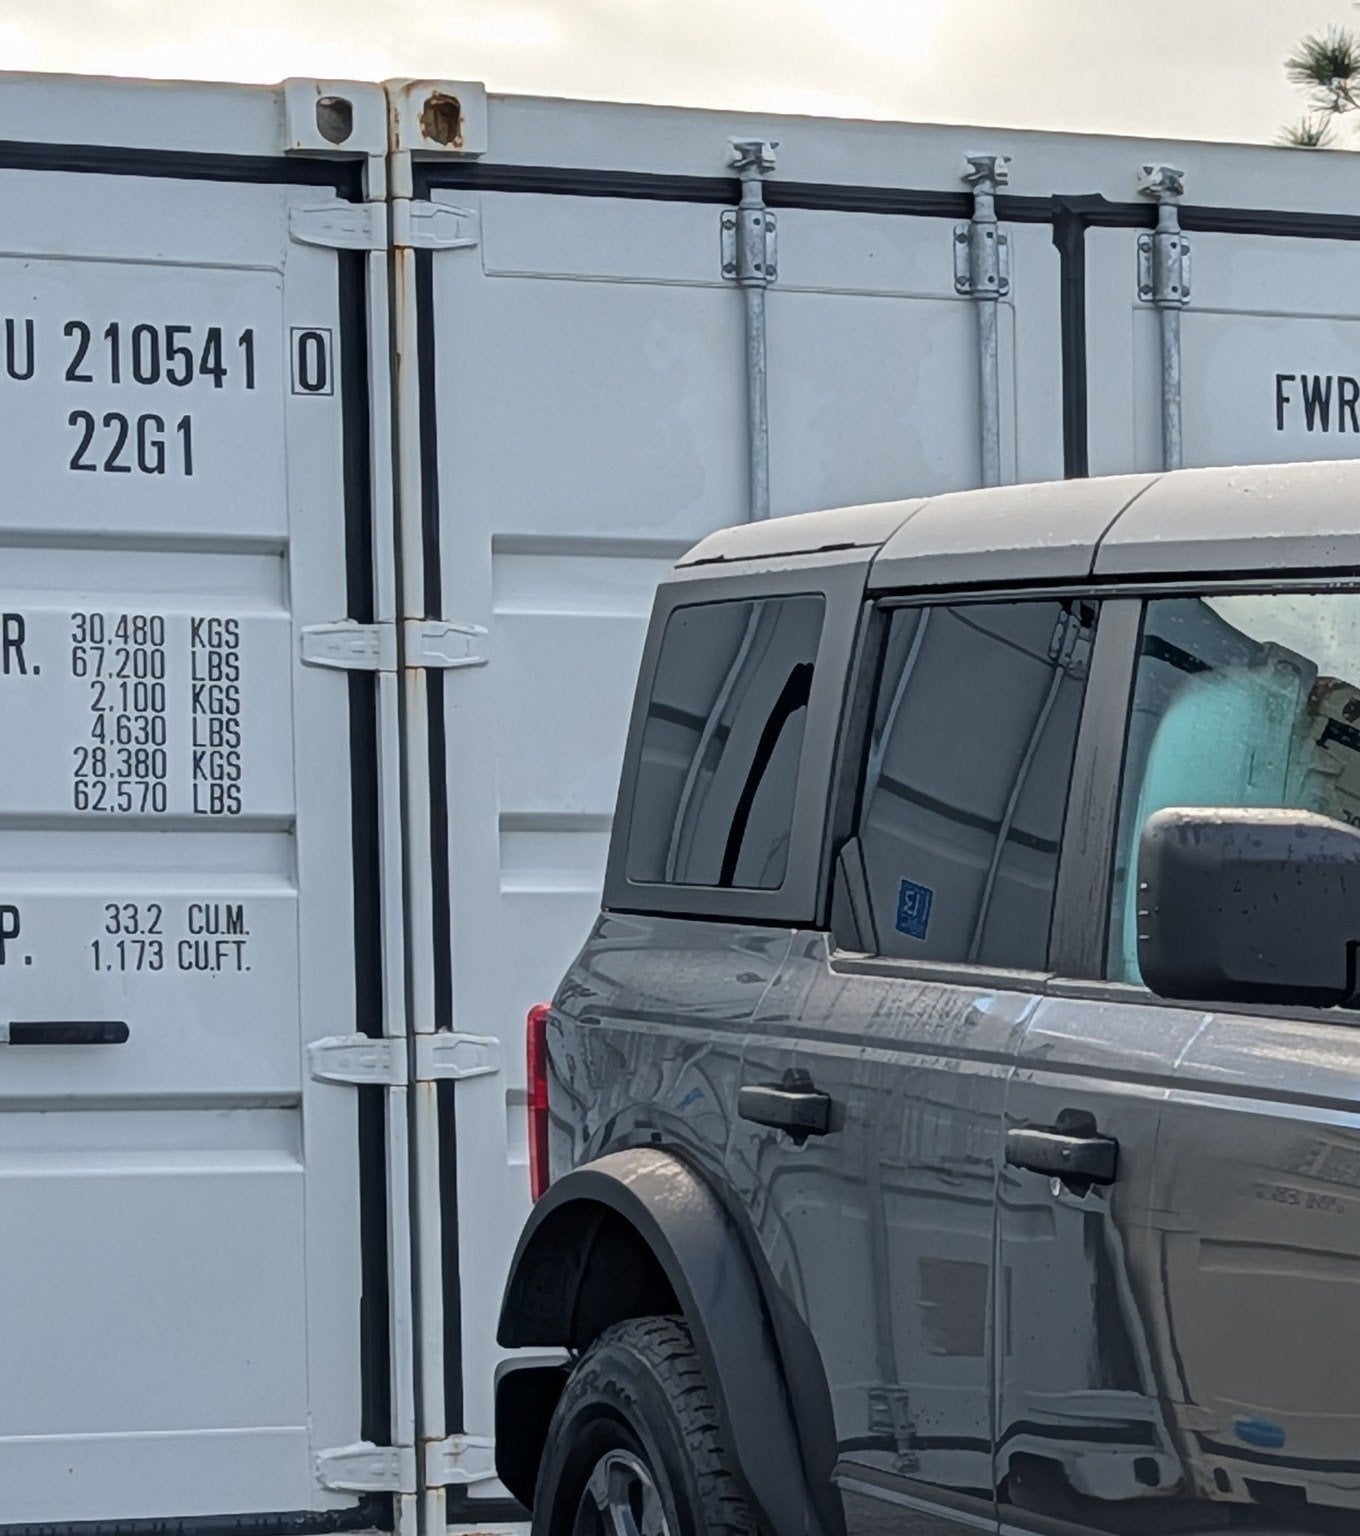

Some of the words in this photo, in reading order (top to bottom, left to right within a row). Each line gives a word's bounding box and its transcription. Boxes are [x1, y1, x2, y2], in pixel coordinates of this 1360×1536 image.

[64, 320, 255, 389] 210541
[68, 410, 193, 476] 22G1
[71, 612, 165, 646] 30.480
[191, 617, 240, 649] KGS
[72, 646, 165, 679] 67.200
[191, 651, 240, 682] LBS
[90, 680, 166, 713] 2.100
[192, 683, 241, 715] KGS
[91, 714, 167, 746] 4.630
[192, 717, 241, 748] LBS
[73, 746, 167, 779] 28.380
[192, 750, 242, 781] KGS
[73, 780, 167, 812] 62.570
[193, 783, 242, 814] LBS
[105, 903, 163, 935] 33.2
[188, 903, 250, 935] CU.M.
[91, 939, 164, 971] 1.173
[178, 939, 251, 971] CU.FT.
